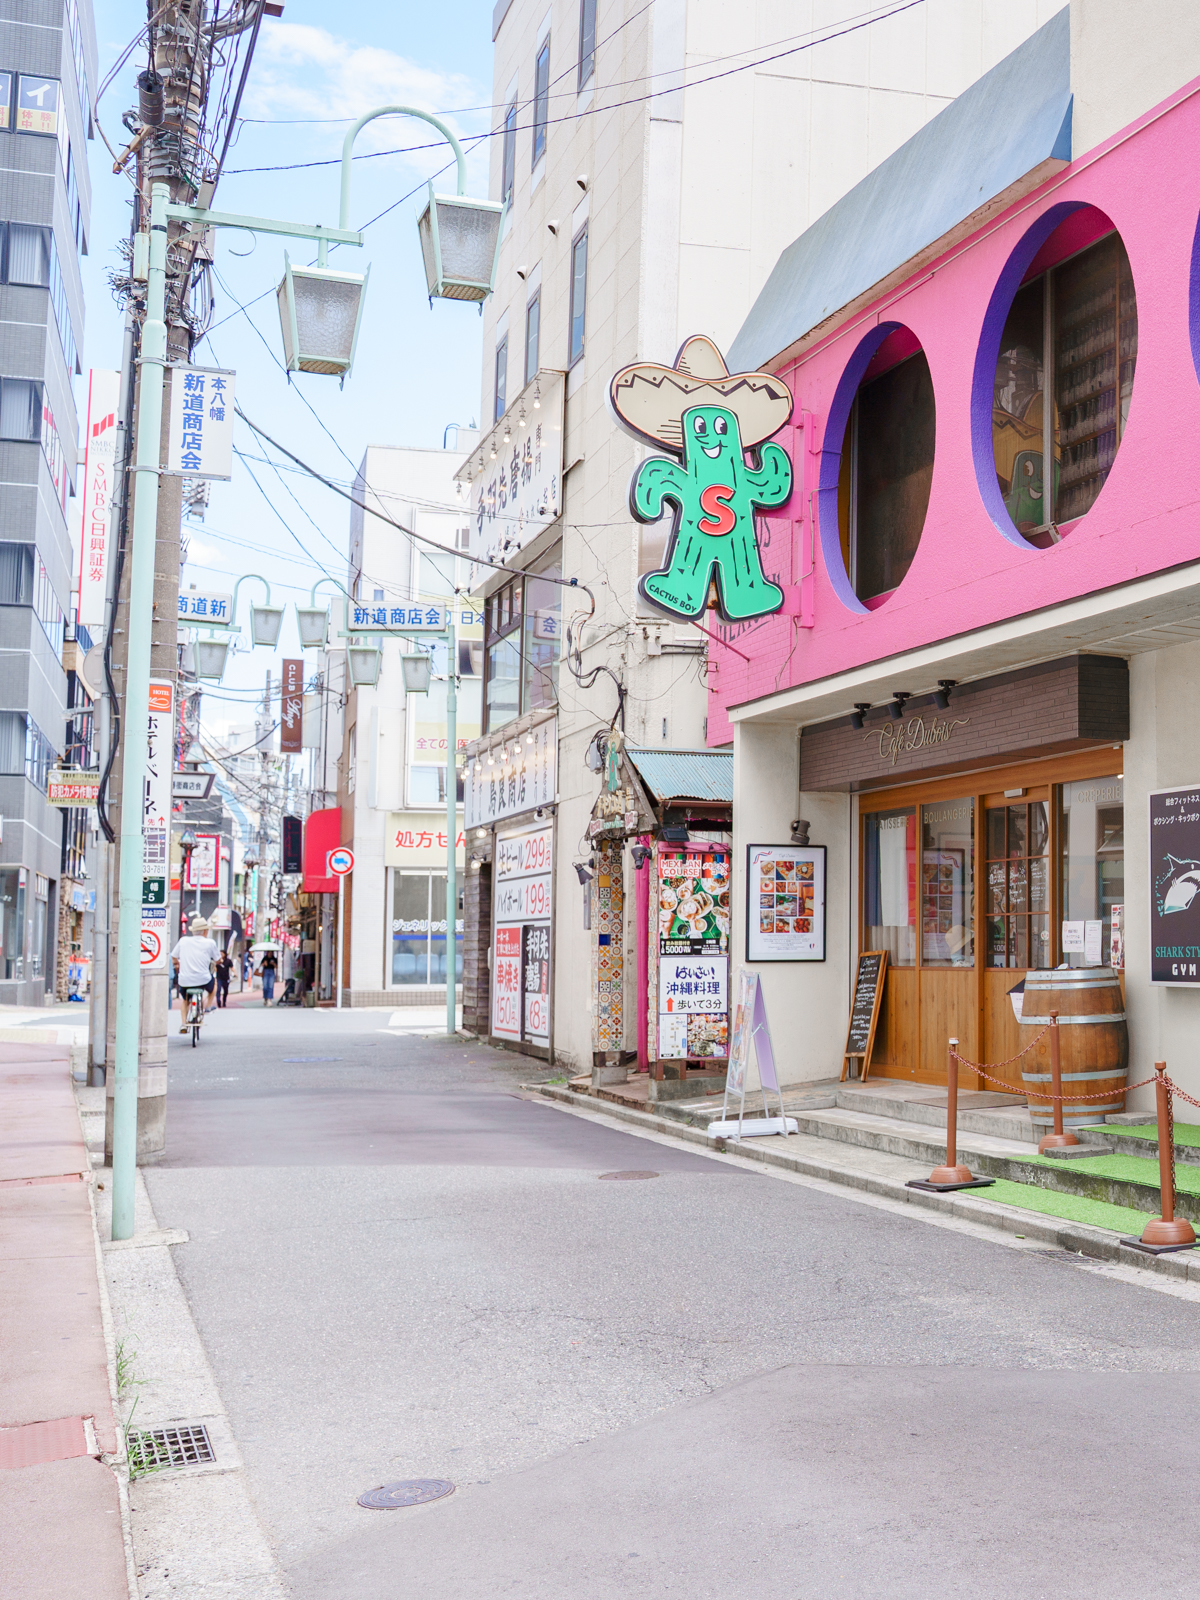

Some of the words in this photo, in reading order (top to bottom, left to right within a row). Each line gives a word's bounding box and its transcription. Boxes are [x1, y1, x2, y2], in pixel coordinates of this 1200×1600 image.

[209, 376, 227, 422] 本八幡
[181, 373, 205, 471] 新道商店会
[699, 484, 736, 535] S
[88, 462, 108, 583] SMBC日興証券
[648, 584, 679, 604] CACTUS
[679, 600, 697, 613] BOY
[353, 607, 441, 626] 新道商店会
[288, 664, 301, 692] CLUB
[863, 722, 906, 766] Café
[905, 714, 971, 751] Dubois
[1165, 794, 1200, 806] 総合フィットネス
[924, 806, 975, 825] BOULANGERIE
[661, 860, 701, 868] MEXIAN
[663, 868, 699, 876] COURSE
[1155, 946, 1185, 959] SHARK
[496, 959, 519, 994] 串焼き
[1171, 963, 1197, 976] GYM
[665, 981, 721, 996] 沖縄料理
[677, 999, 722, 1010] 歩いて3分
